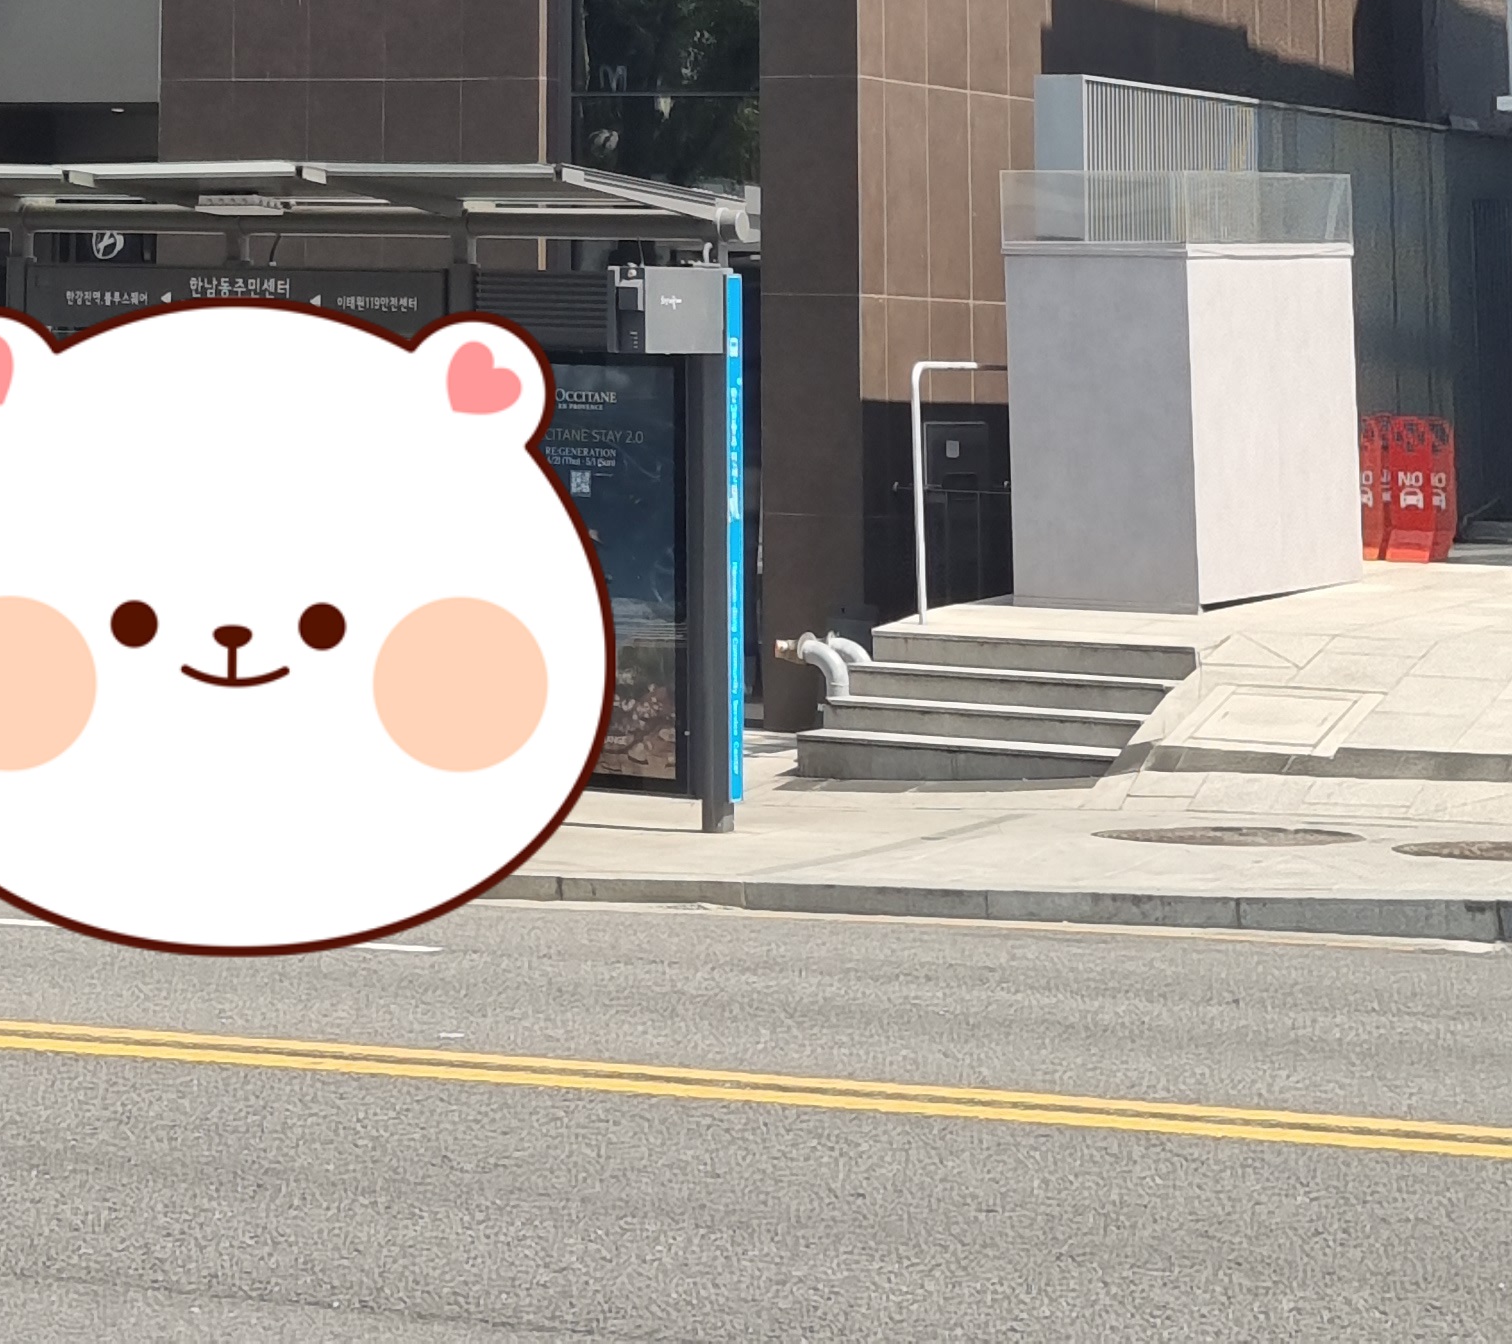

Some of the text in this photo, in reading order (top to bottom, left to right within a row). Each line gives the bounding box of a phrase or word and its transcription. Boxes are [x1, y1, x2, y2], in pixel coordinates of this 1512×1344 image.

[189, 276, 290, 299] 한남동주민센터
[591, 429, 622, 443] STAY
[625, 430, 644, 444] 2.0
[1397, 471, 1423, 487] NO
